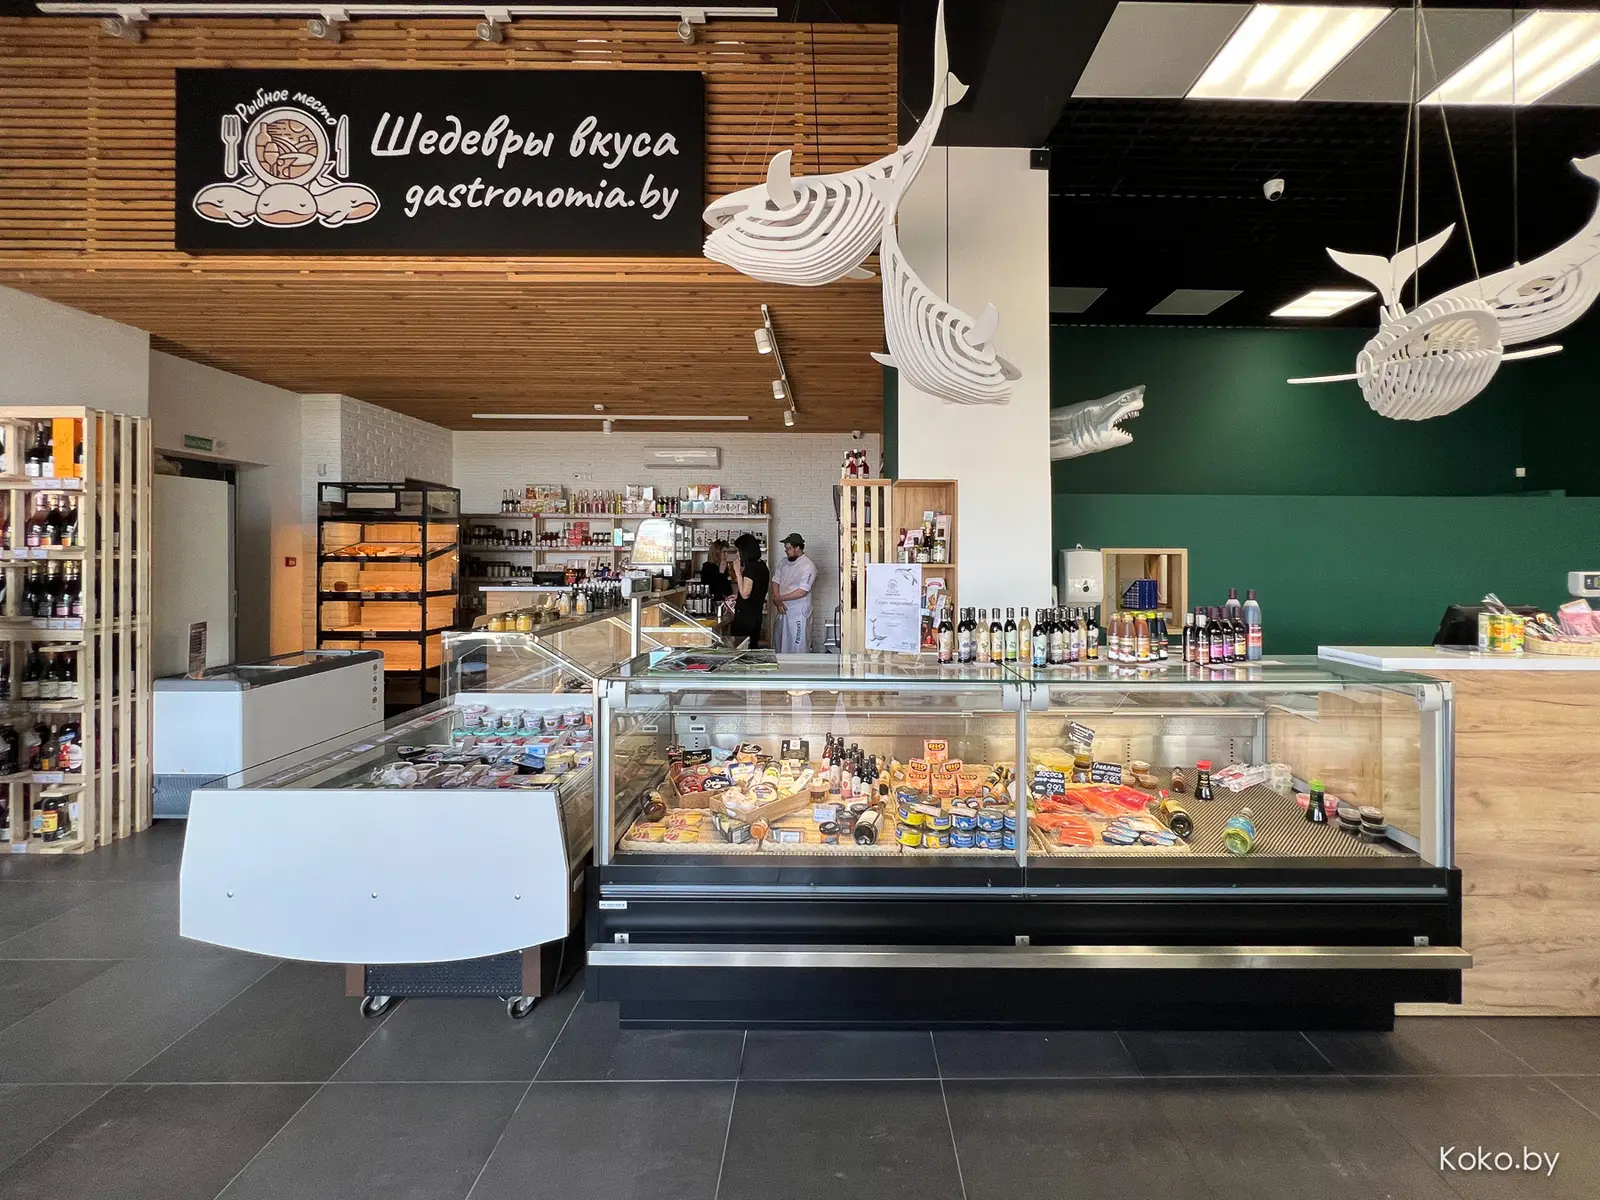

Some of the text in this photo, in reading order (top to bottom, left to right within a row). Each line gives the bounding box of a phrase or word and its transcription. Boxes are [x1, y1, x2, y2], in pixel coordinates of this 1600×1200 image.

[235, 87, 337, 125] Рыбное место
[370, 111, 680, 170] Шедевры вкуса
[403, 173, 680, 220] gastronomia.by
